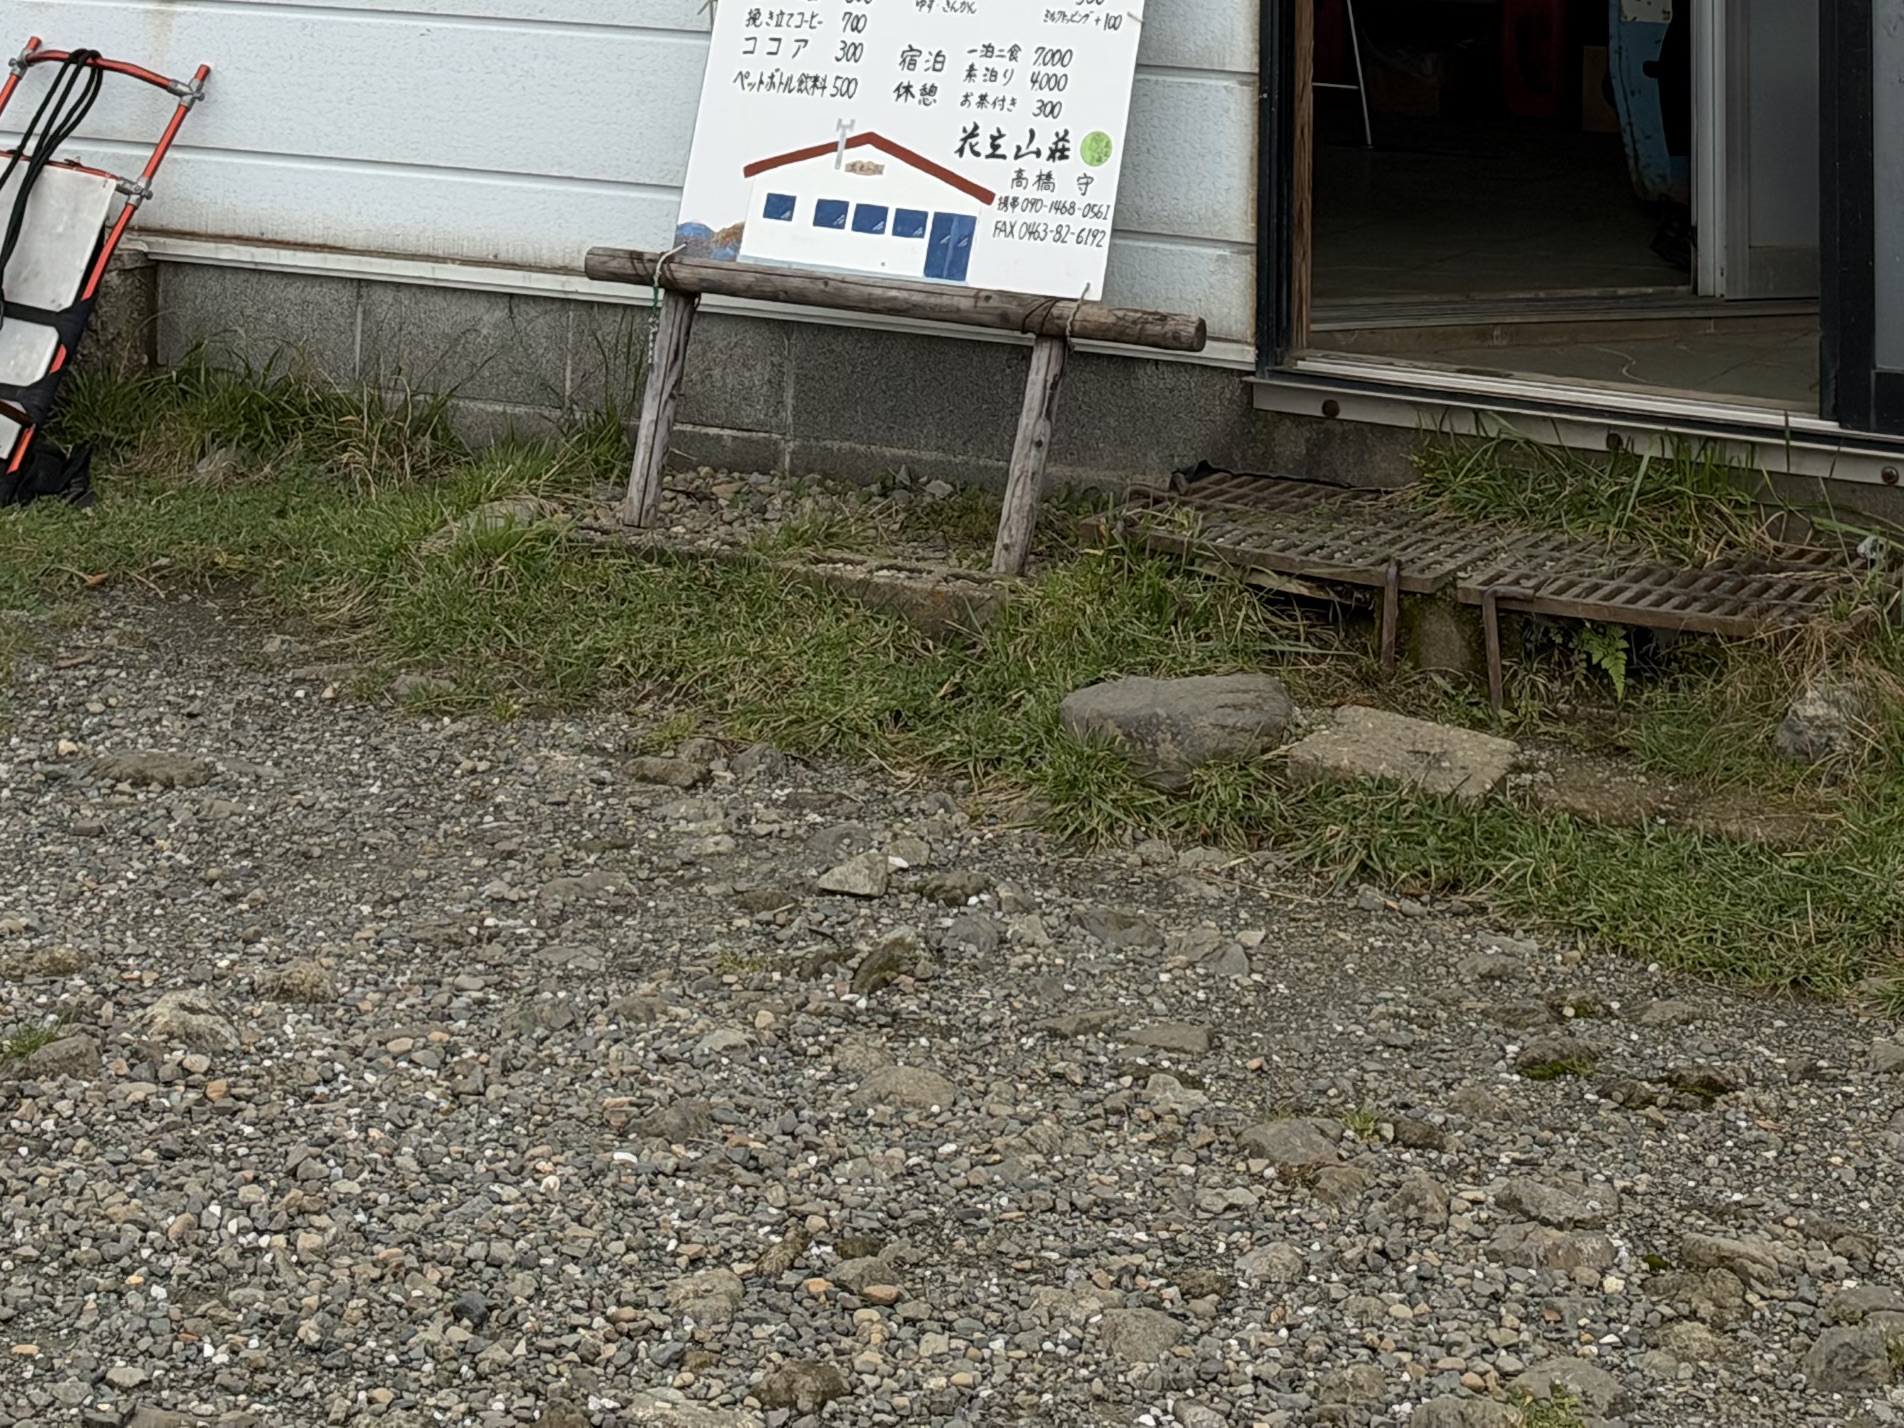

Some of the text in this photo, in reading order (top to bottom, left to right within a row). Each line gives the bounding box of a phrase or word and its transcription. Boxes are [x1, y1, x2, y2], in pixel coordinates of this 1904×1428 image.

[841, 11, 868, 34] 700
[742, 36, 864, 63] ココア 300
[898, 44, 946, 73] 宿泊
[966, 42, 1022, 63] 一泊二食
[732, 67, 859, 99] ペットボトル飲料 500
[963, 61, 1016, 86] 素泊り
[892, 80, 938, 107] 休憩
[959, 92, 1063, 120] お茶付き 300
[954, 120, 1072, 163] 花立山荘
[1011, 167, 1095, 196] 高橋 守
[997, 195, 1020, 213] 携帯
[993, 220, 1107, 248] FAX 0463-82-6192
